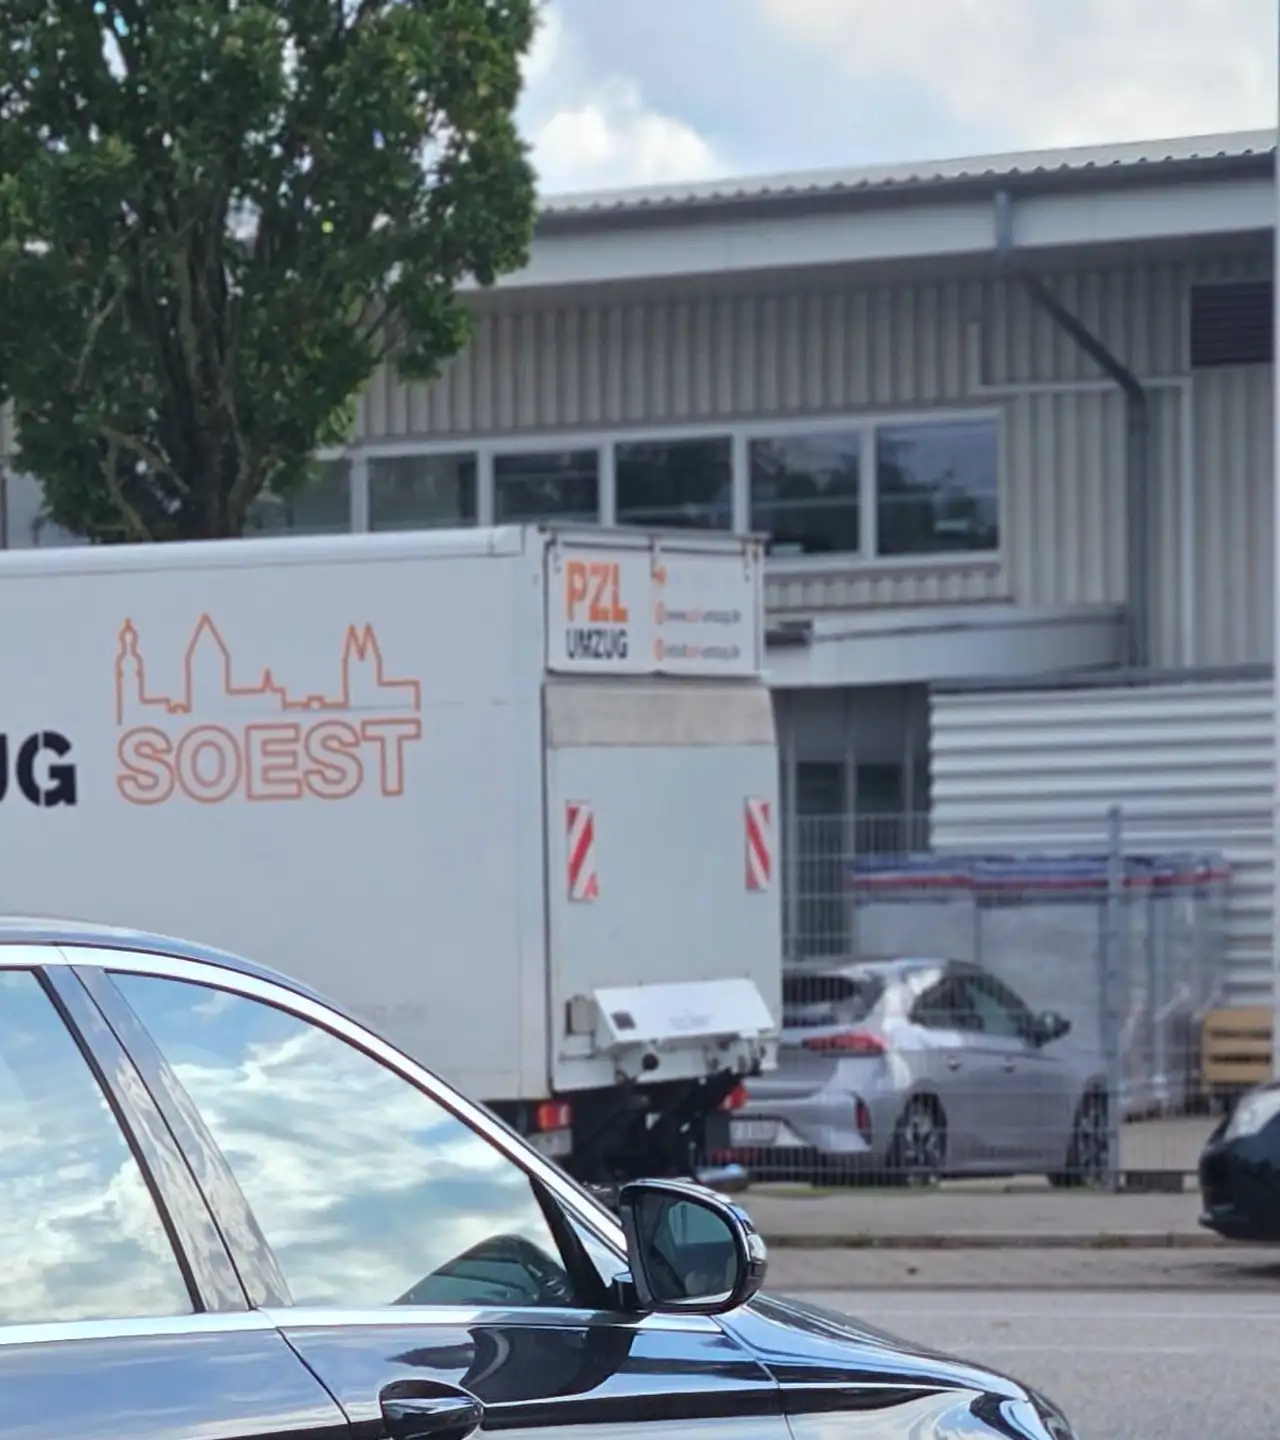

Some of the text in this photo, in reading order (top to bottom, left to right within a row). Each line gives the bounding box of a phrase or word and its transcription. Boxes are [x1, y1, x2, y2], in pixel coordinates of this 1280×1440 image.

[566, 560, 629, 623] PZL
[565, 628, 629, 660] UMZUG
[116, 718, 423, 806] SOEST
